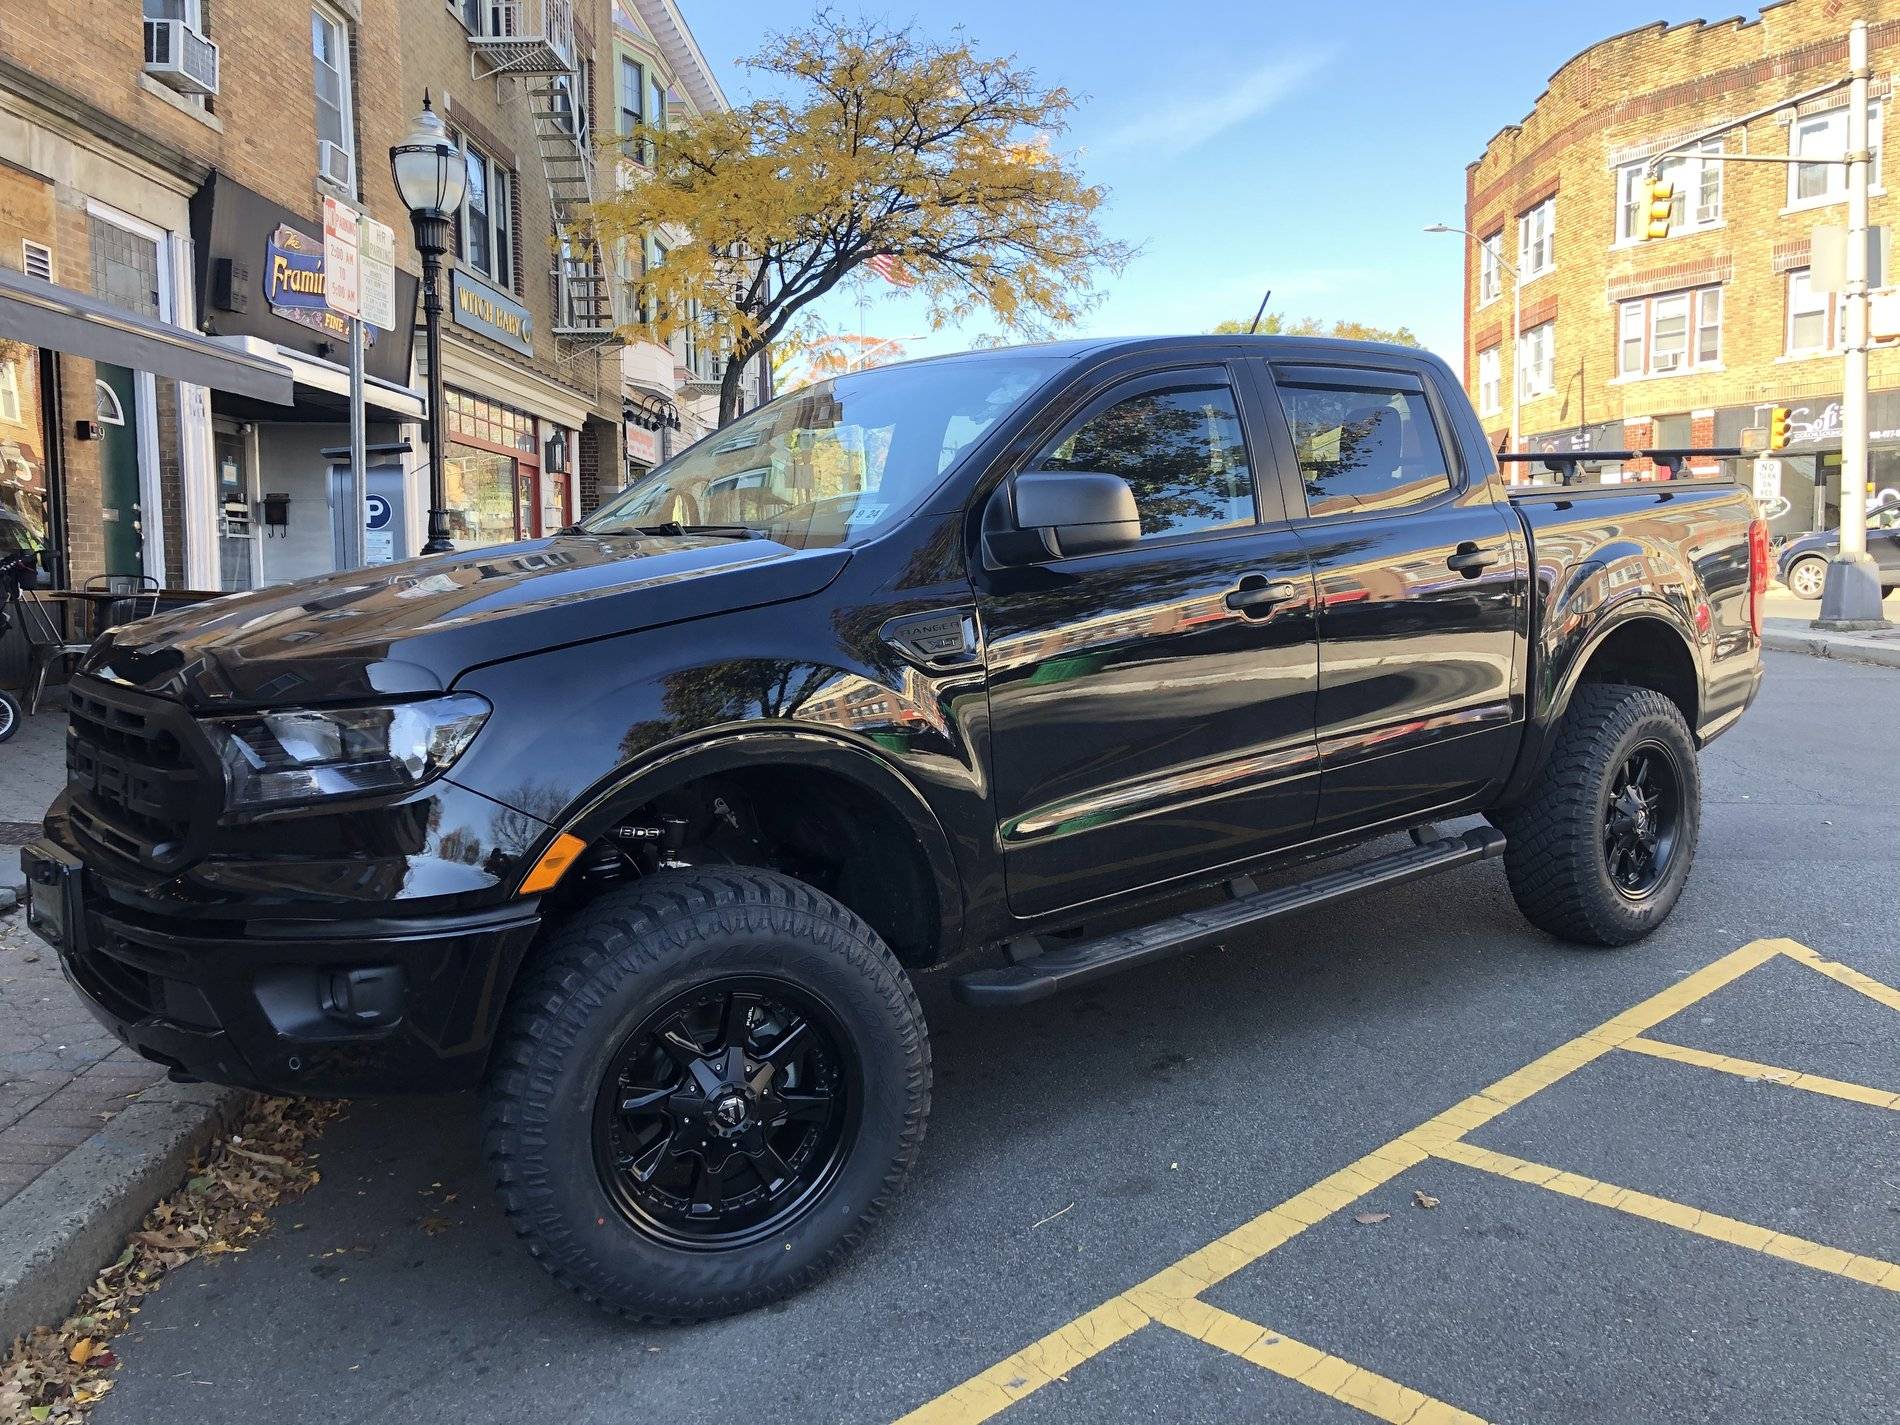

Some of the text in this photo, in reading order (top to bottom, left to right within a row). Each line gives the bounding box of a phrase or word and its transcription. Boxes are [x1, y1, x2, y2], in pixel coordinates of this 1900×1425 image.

[335, 214, 356, 236] PARKING
[284, 231, 302, 250] The
[376, 229, 386, 245] HR
[331, 243, 354, 265] 2:00 AM
[271, 254, 326, 298] Framin
[347, 288, 356, 302] AM
[458, 286, 520, 337] WITCH BABY
[324, 313, 344, 333] FINE
[1761, 463, 1775, 472] NO
[366, 500, 384, 524] P
[902, 621, 961, 636] RANGER
[619, 825, 660, 839] BDS
